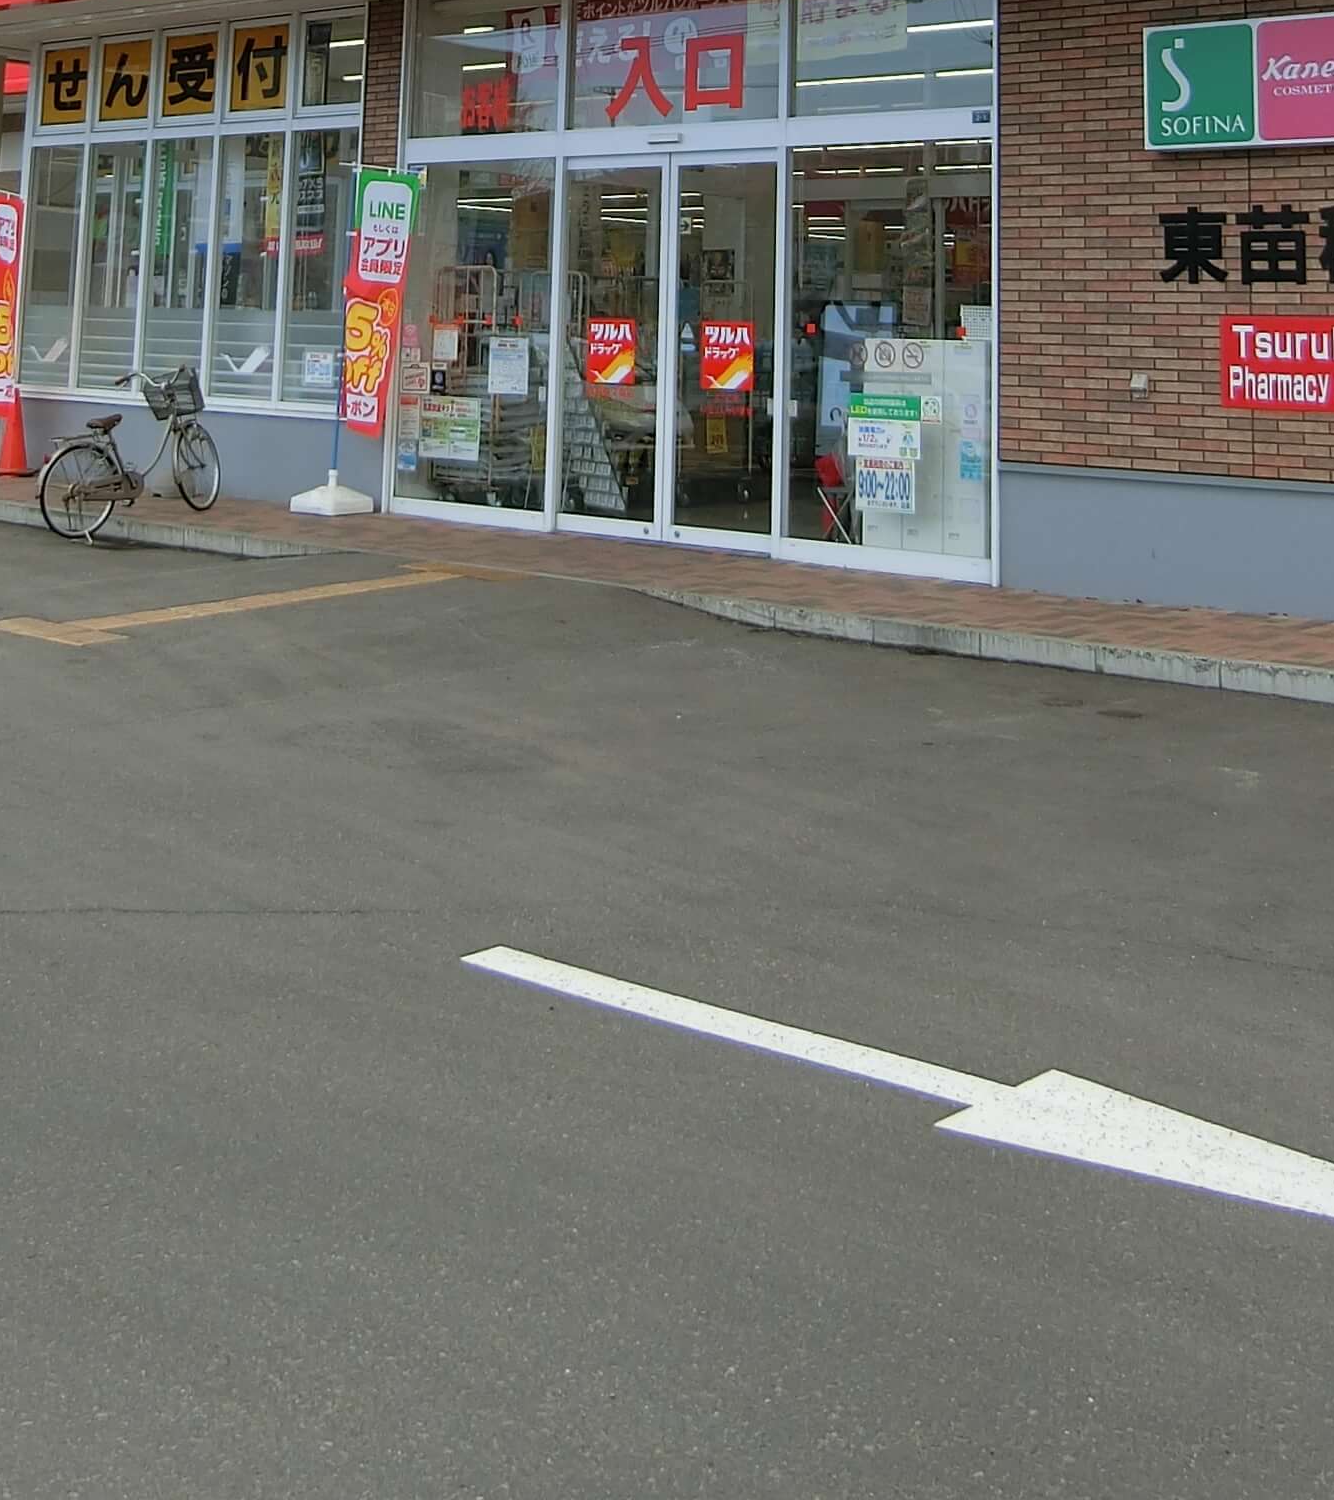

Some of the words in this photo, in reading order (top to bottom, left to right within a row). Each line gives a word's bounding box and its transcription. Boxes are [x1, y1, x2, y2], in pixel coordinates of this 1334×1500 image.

[47, 34, 286, 110] せん受付
[605, 32, 747, 118] 入口
[1160, 114, 1246, 138] SOFINA
[369, 201, 406, 220] LINE
[373, 223, 399, 234] もしくは
[363, 236, 406, 259] アプリ
[360, 259, 403, 275] 会員限定
[590, 323, 632, 341] ツルハ
[704, 326, 751, 345] ツルハ
[590, 342, 622, 355] ドラッグ
[704, 346, 740, 360] ドラッグ
[1229, 365, 1331, 404] Pharmacy
